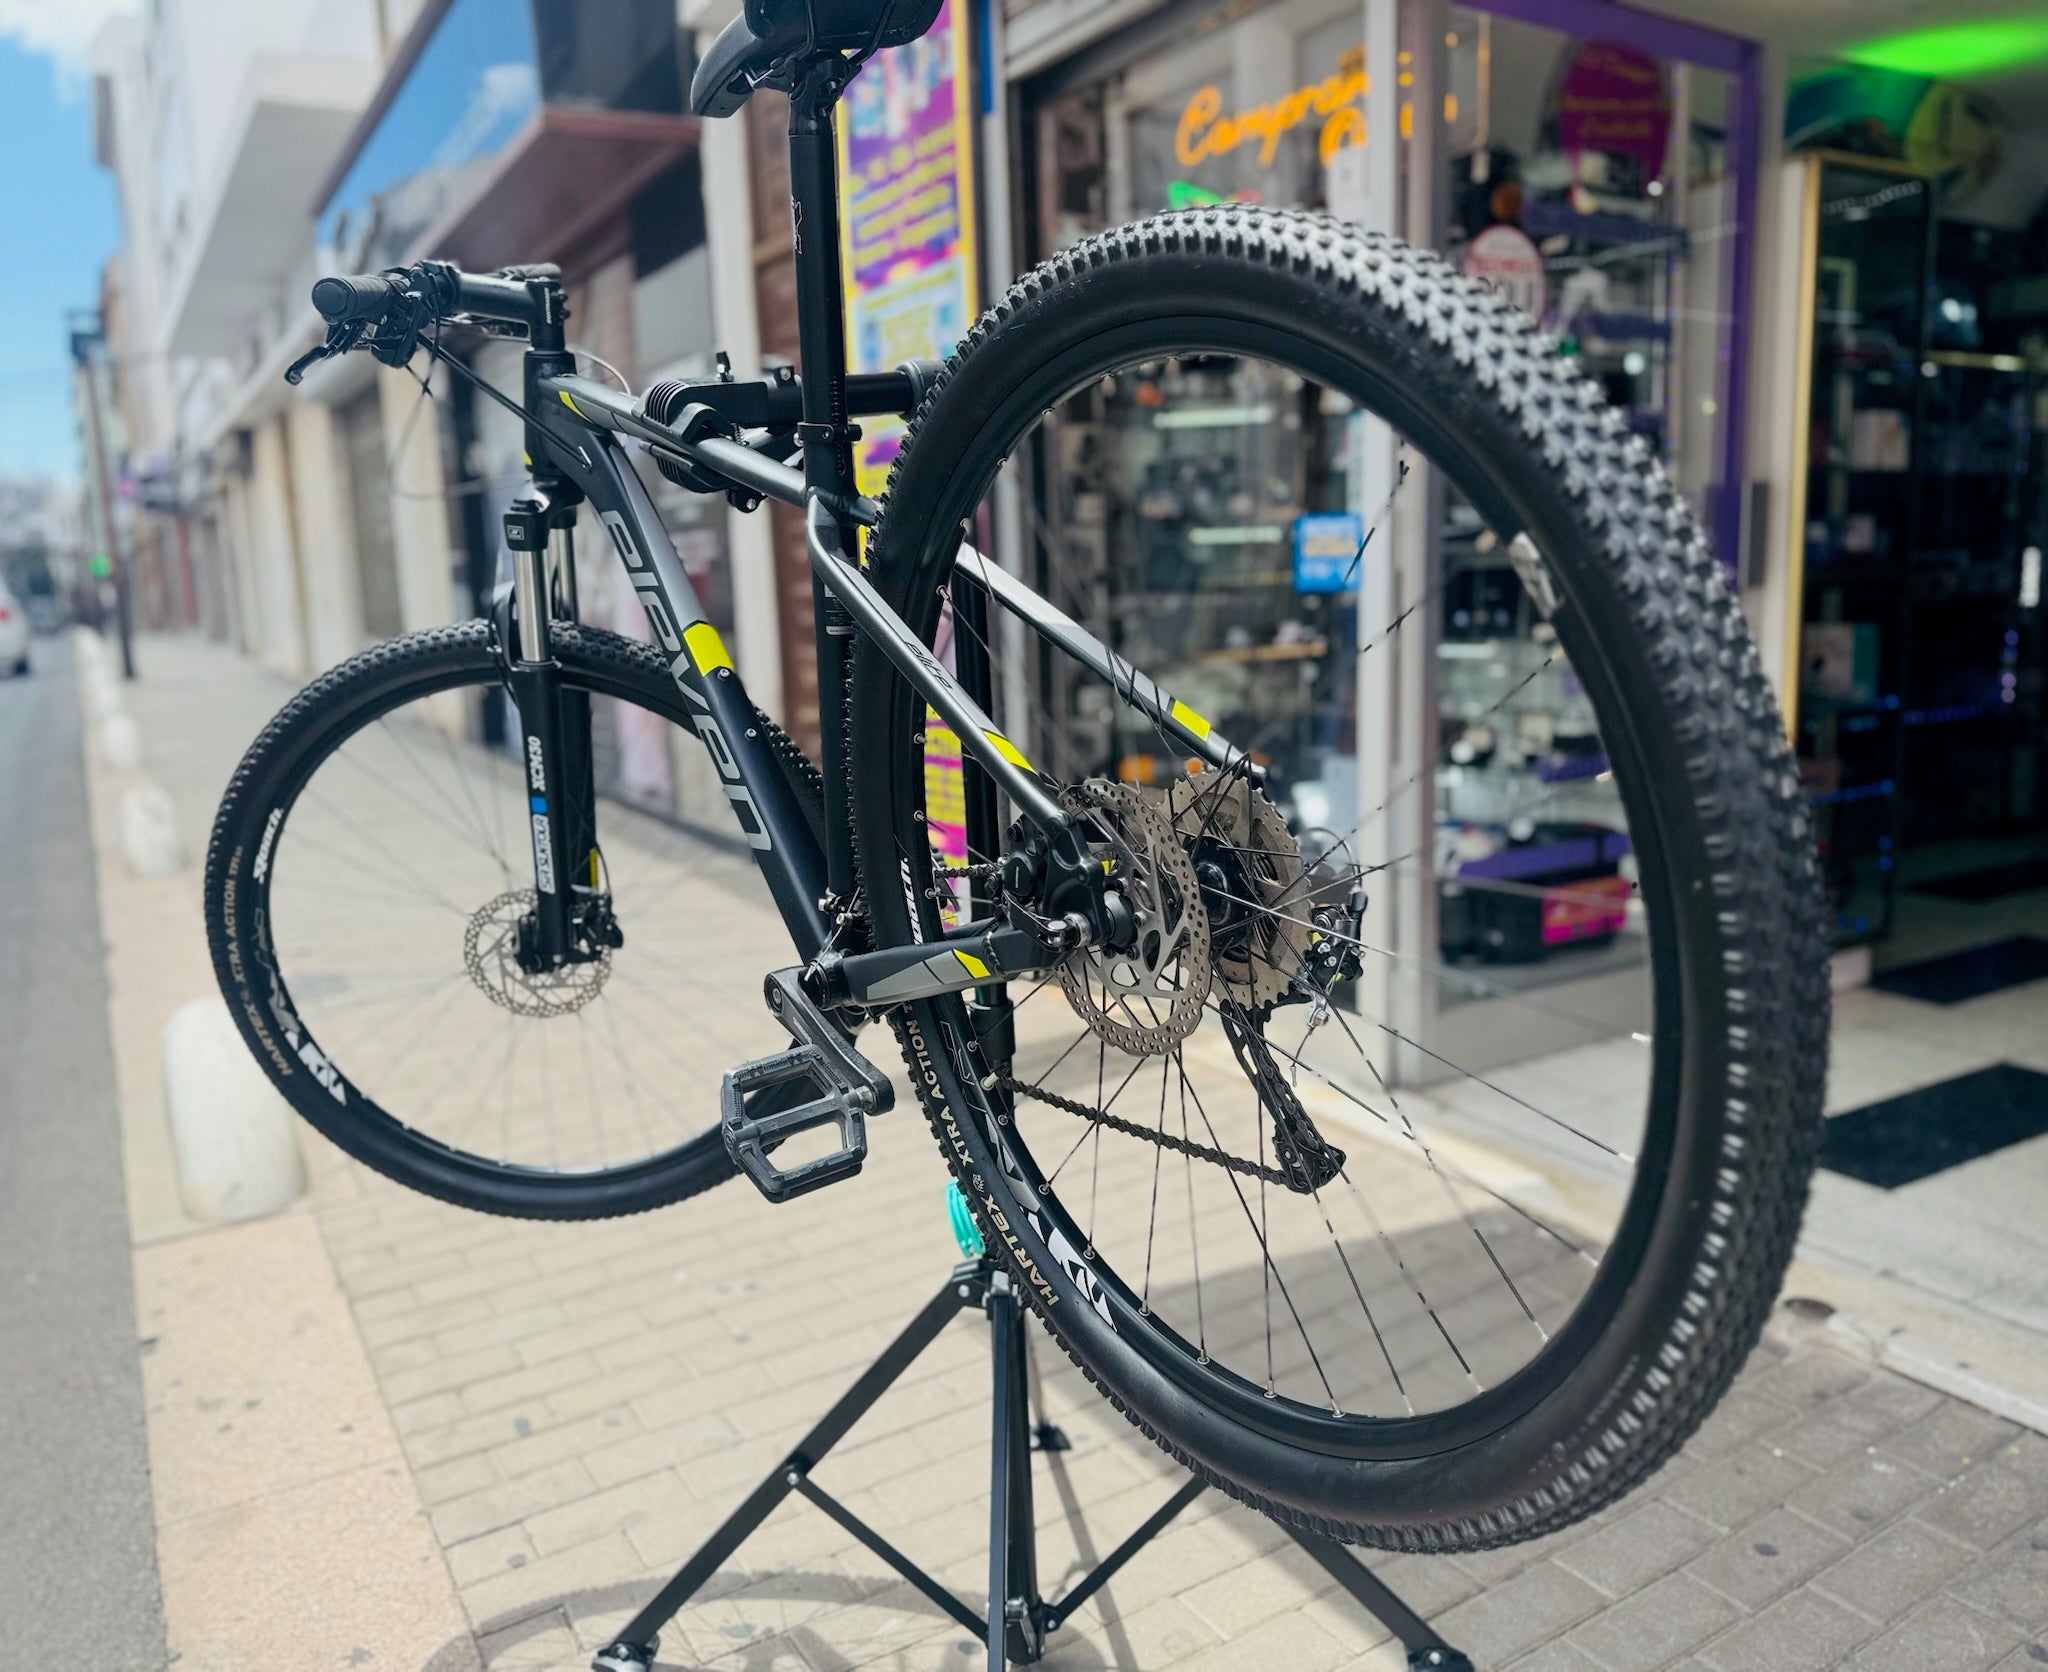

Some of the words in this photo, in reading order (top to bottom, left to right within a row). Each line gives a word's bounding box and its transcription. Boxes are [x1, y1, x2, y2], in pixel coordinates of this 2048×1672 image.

[602, 510, 772, 851] eleven
[223, 878, 236, 937] ACTION
[244, 1003, 293, 1077] HARTEX
[906, 1018, 945, 1101] ACTION
[939, 1105, 974, 1168] XTRA
[981, 1194, 1060, 1306] HARTEX
